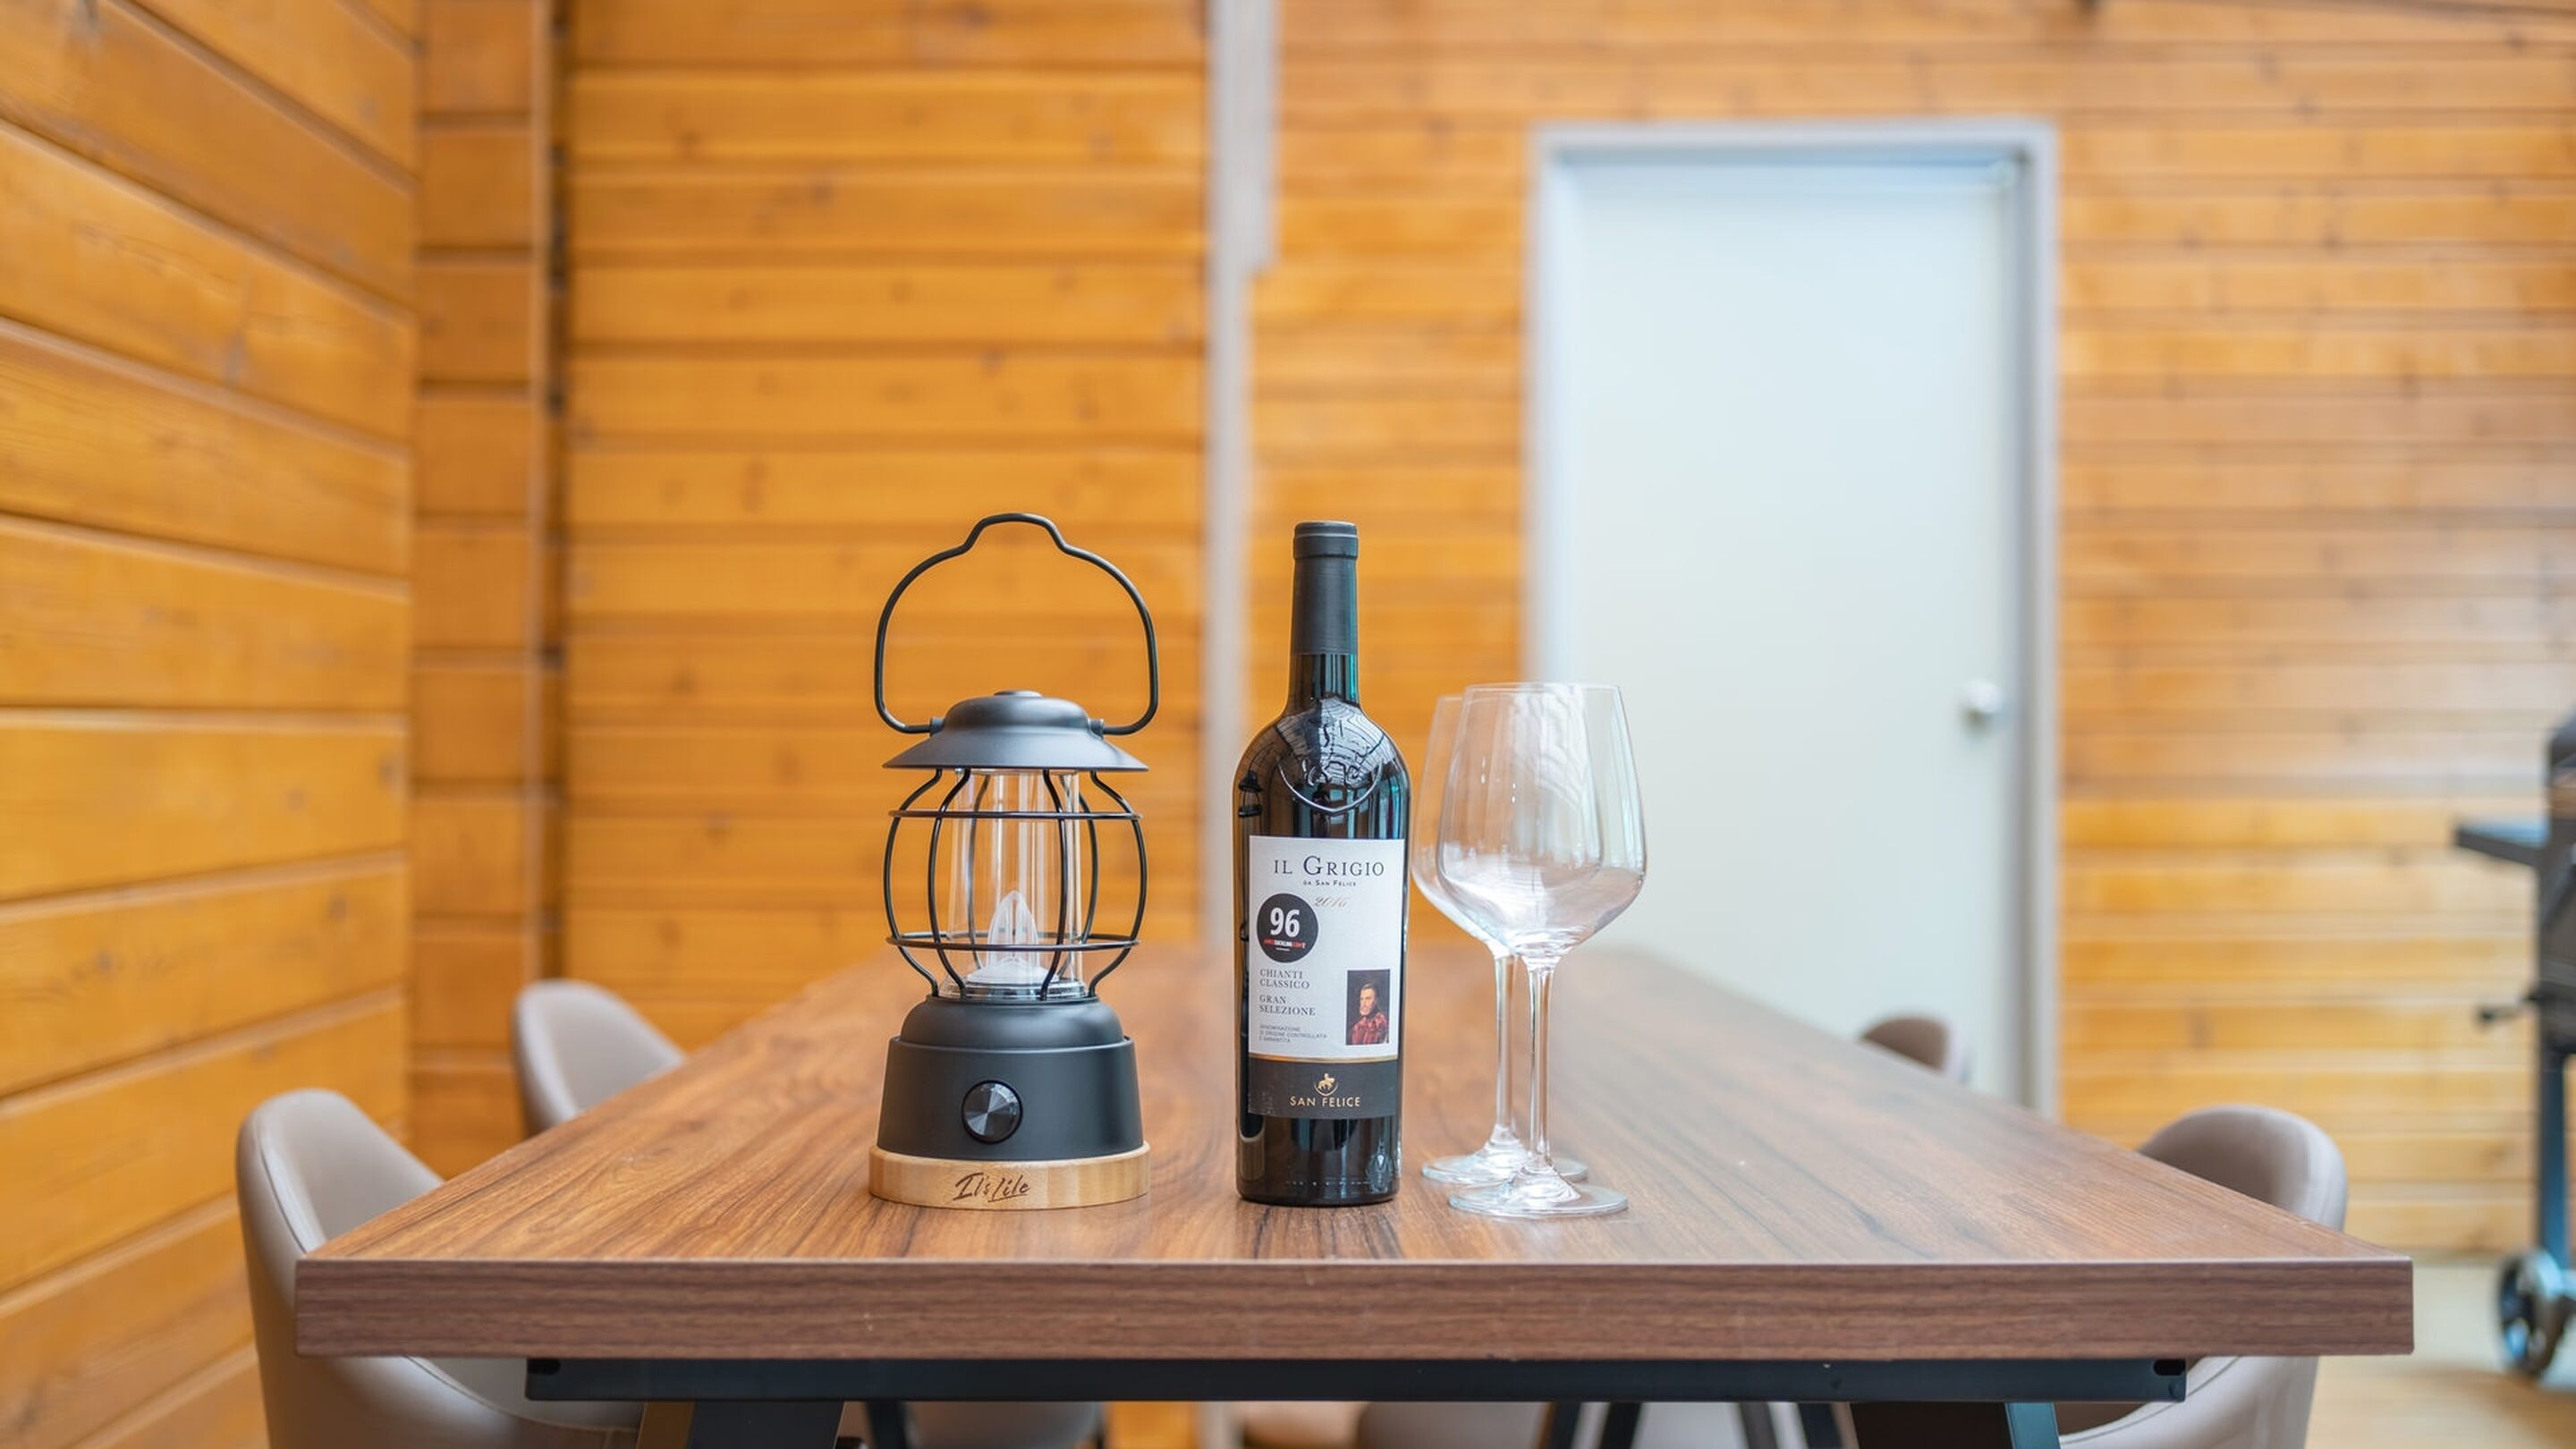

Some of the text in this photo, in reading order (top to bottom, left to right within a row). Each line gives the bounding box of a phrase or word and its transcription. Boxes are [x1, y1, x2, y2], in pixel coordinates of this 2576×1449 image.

[1274, 855, 1385, 877] IL GRIGIO
[1269, 907, 1301, 937] 96
[1259, 969, 1302, 979] CHIANTI
[1259, 979, 1309, 989] CLASSICO
[1259, 995, 1286, 1004] GRAN
[1259, 1004, 1316, 1016] SELEZIONE
[1289, 1096, 1360, 1107] SAN FELICE
